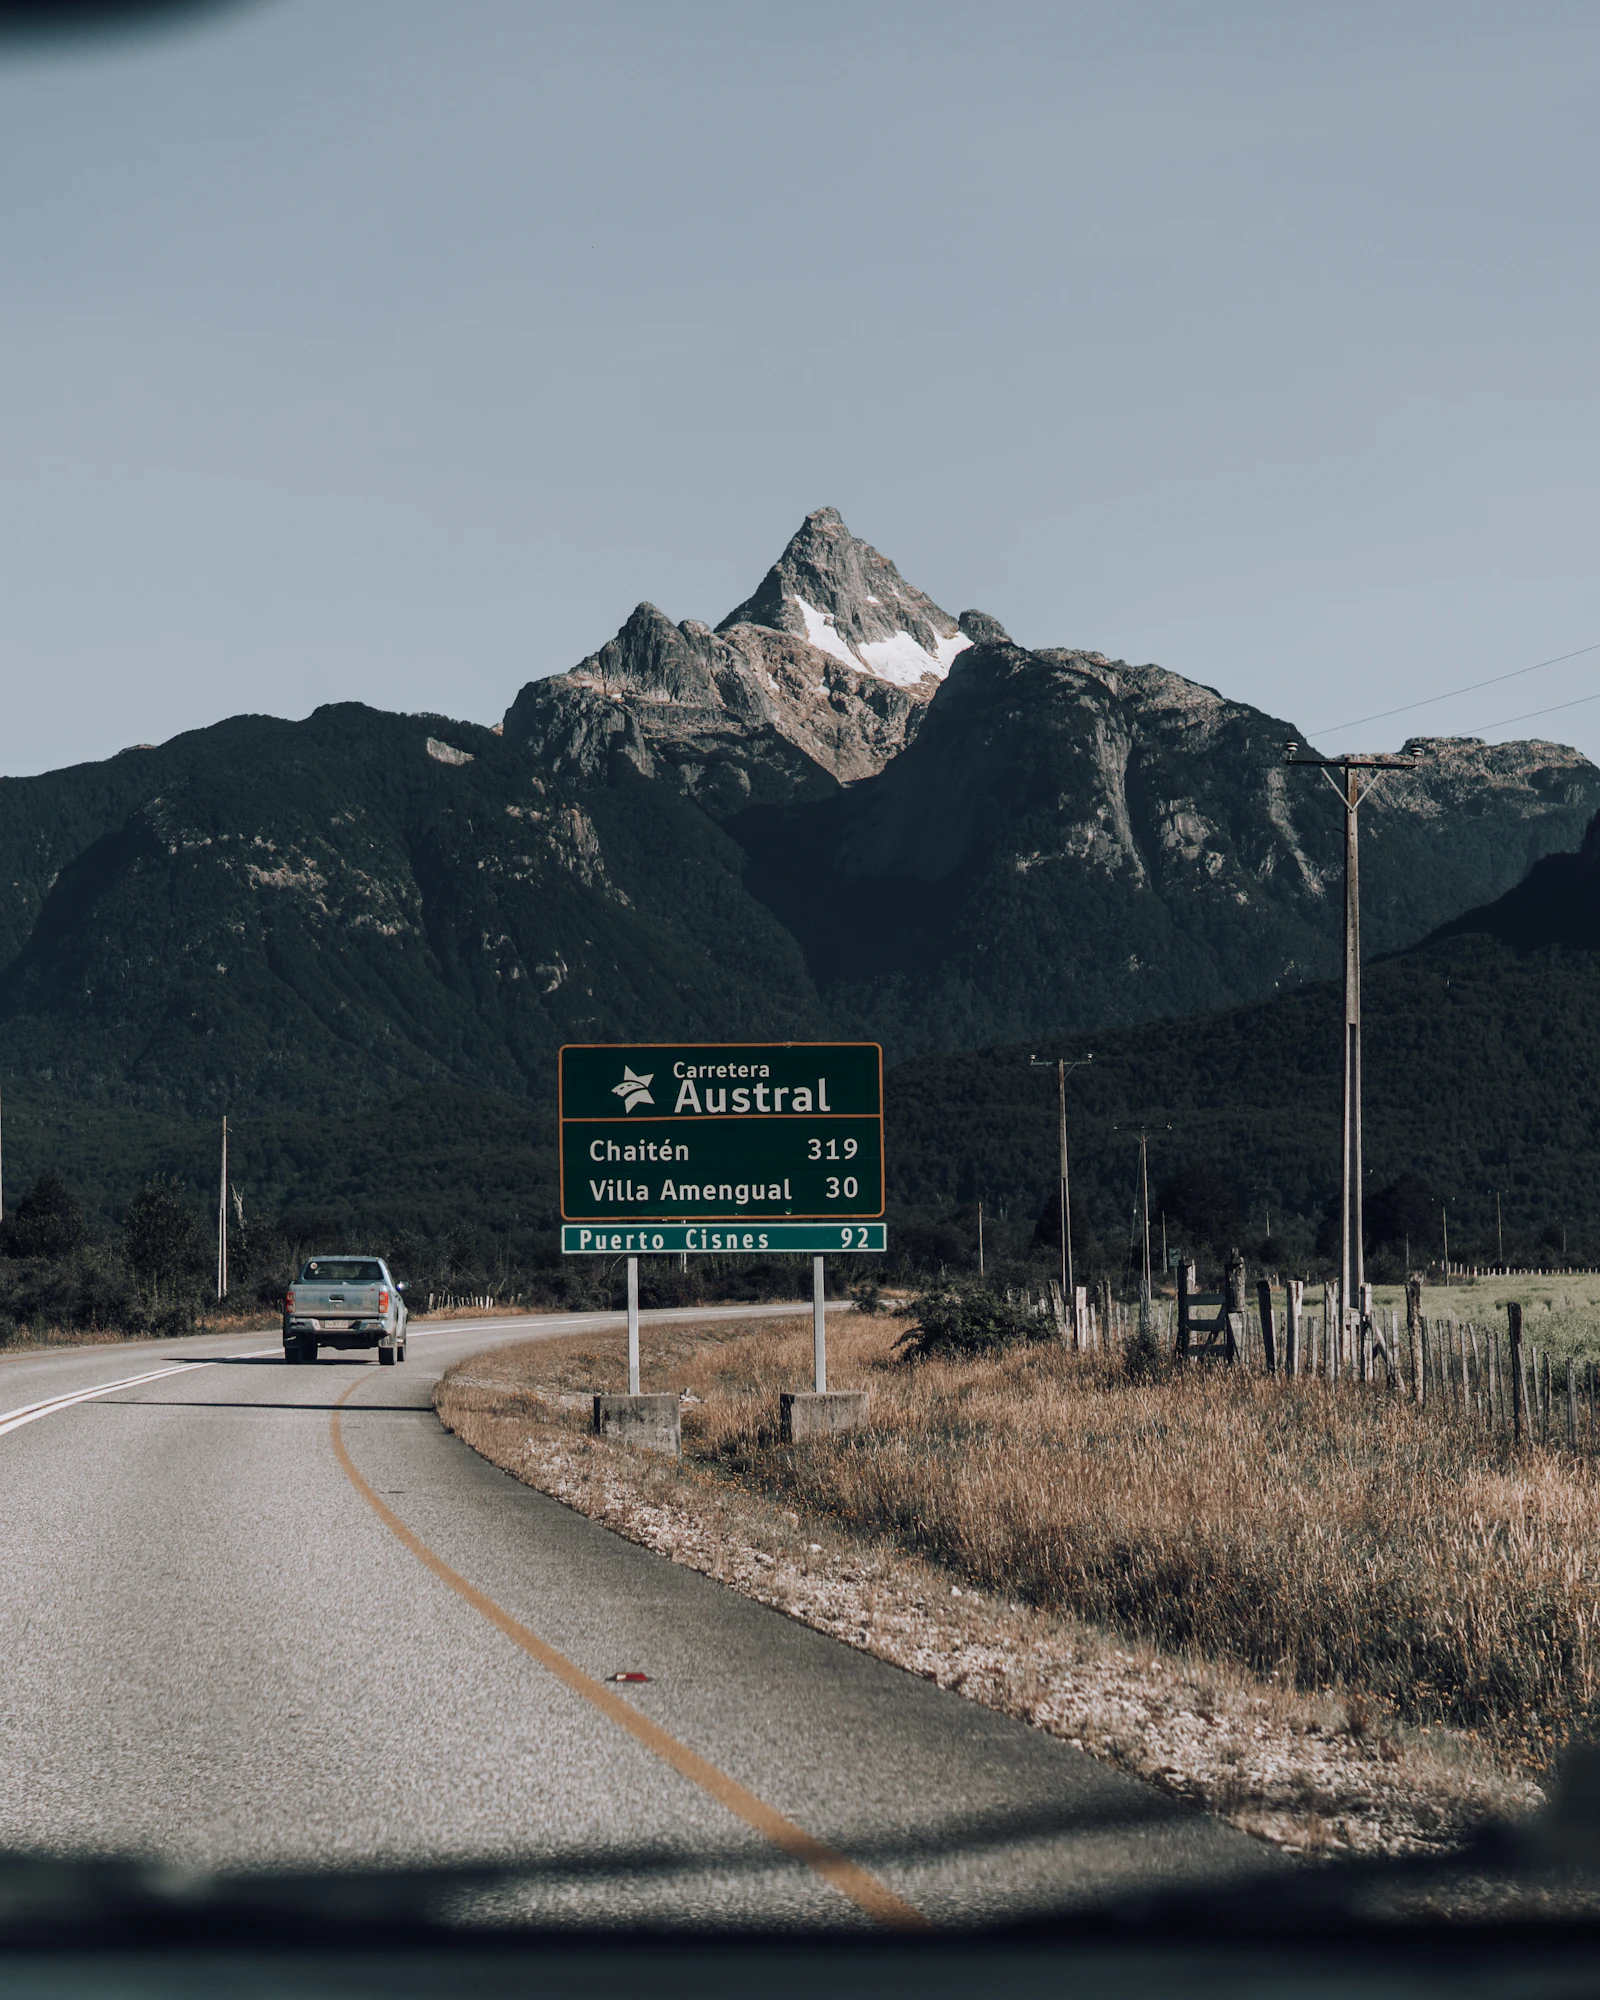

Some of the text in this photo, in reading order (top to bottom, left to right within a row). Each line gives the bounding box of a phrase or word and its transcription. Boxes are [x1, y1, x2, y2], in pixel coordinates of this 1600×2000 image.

[674, 1062, 769, 1078] Carretera
[674, 1078, 830, 1113] Austral
[590, 1139, 857, 1161] Chaitén 319
[590, 1177, 857, 1204] Villa Amengual 30
[580, 1227, 869, 1250] Puerto Cisnes 92
